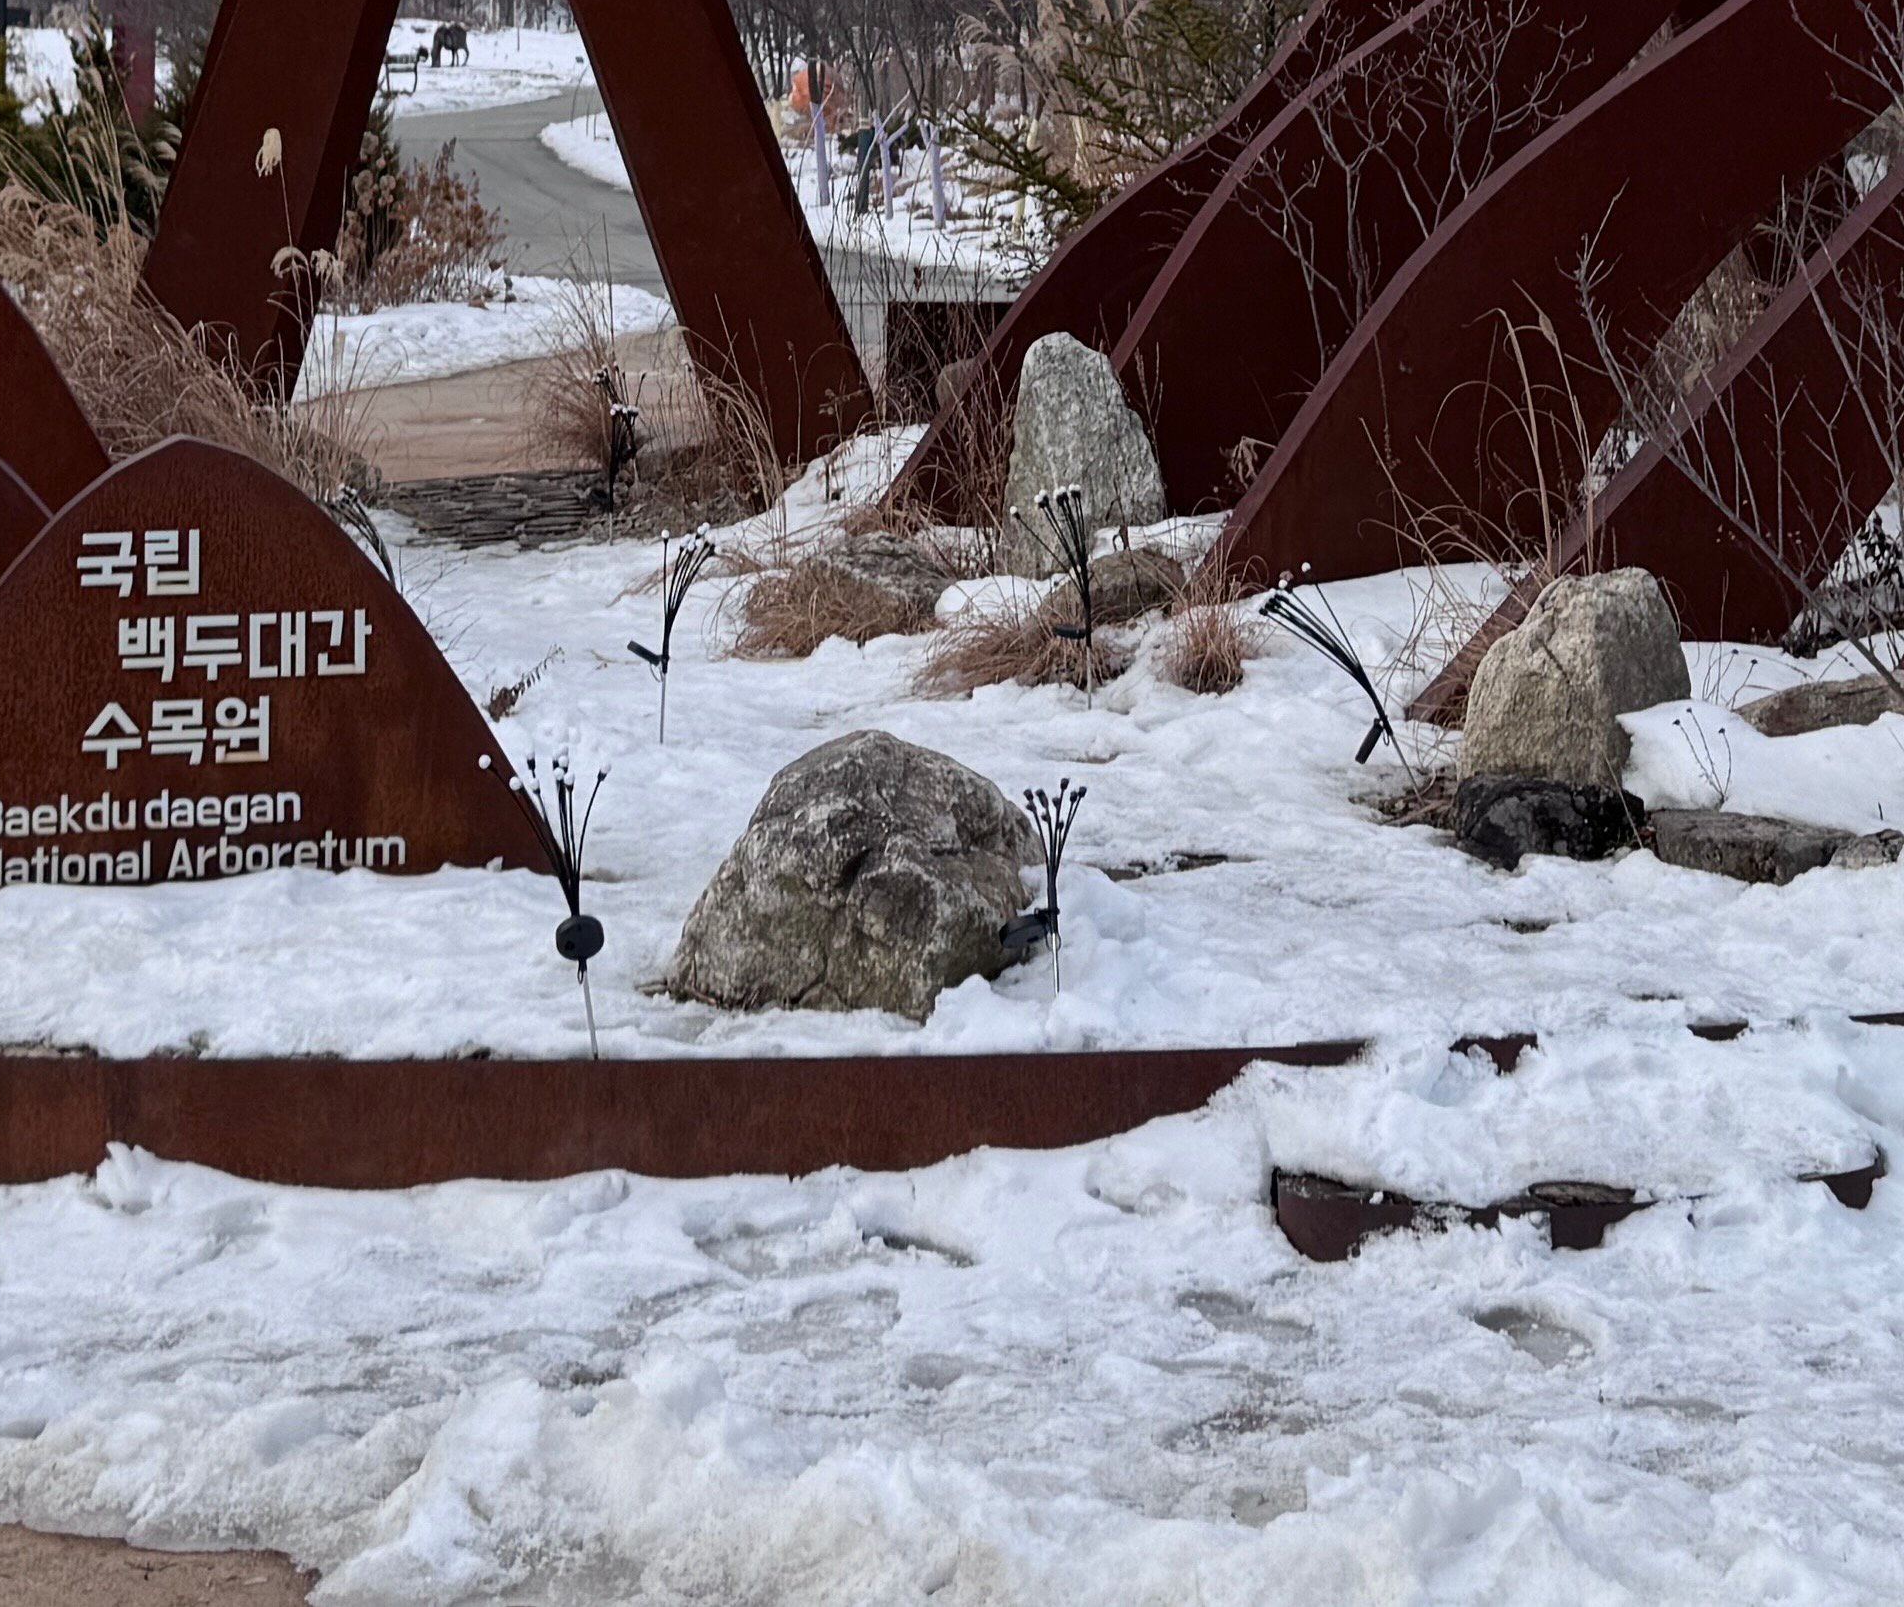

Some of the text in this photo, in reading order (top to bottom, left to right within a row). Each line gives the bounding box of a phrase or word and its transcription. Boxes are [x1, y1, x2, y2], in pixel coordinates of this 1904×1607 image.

[77, 529, 201, 598] 국립
[118, 609, 372, 683] 백두대간
[82, 696, 270, 770] 수목원
[167, 830, 406, 880] Arboretum
